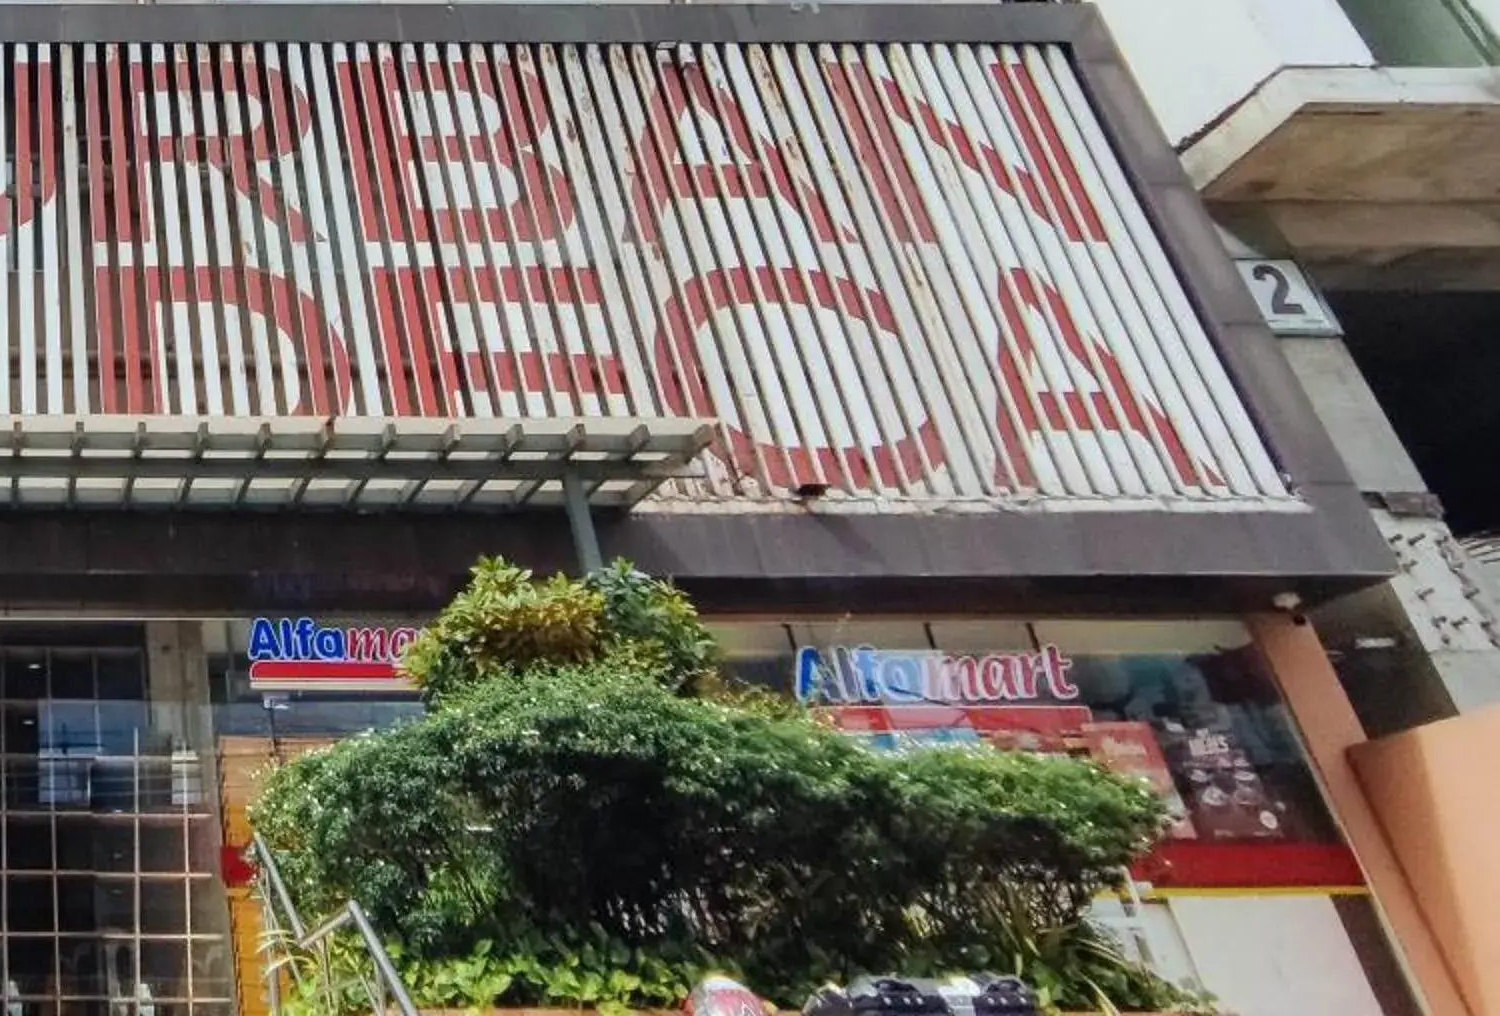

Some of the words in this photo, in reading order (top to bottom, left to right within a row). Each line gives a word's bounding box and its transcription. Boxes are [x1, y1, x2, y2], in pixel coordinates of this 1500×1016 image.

[1252, 264, 1306, 315] 2
[95, 266, 1229, 487] DECA
[248, 617, 430, 662] Alfama
[796, 643, 1081, 702] Alfamart
